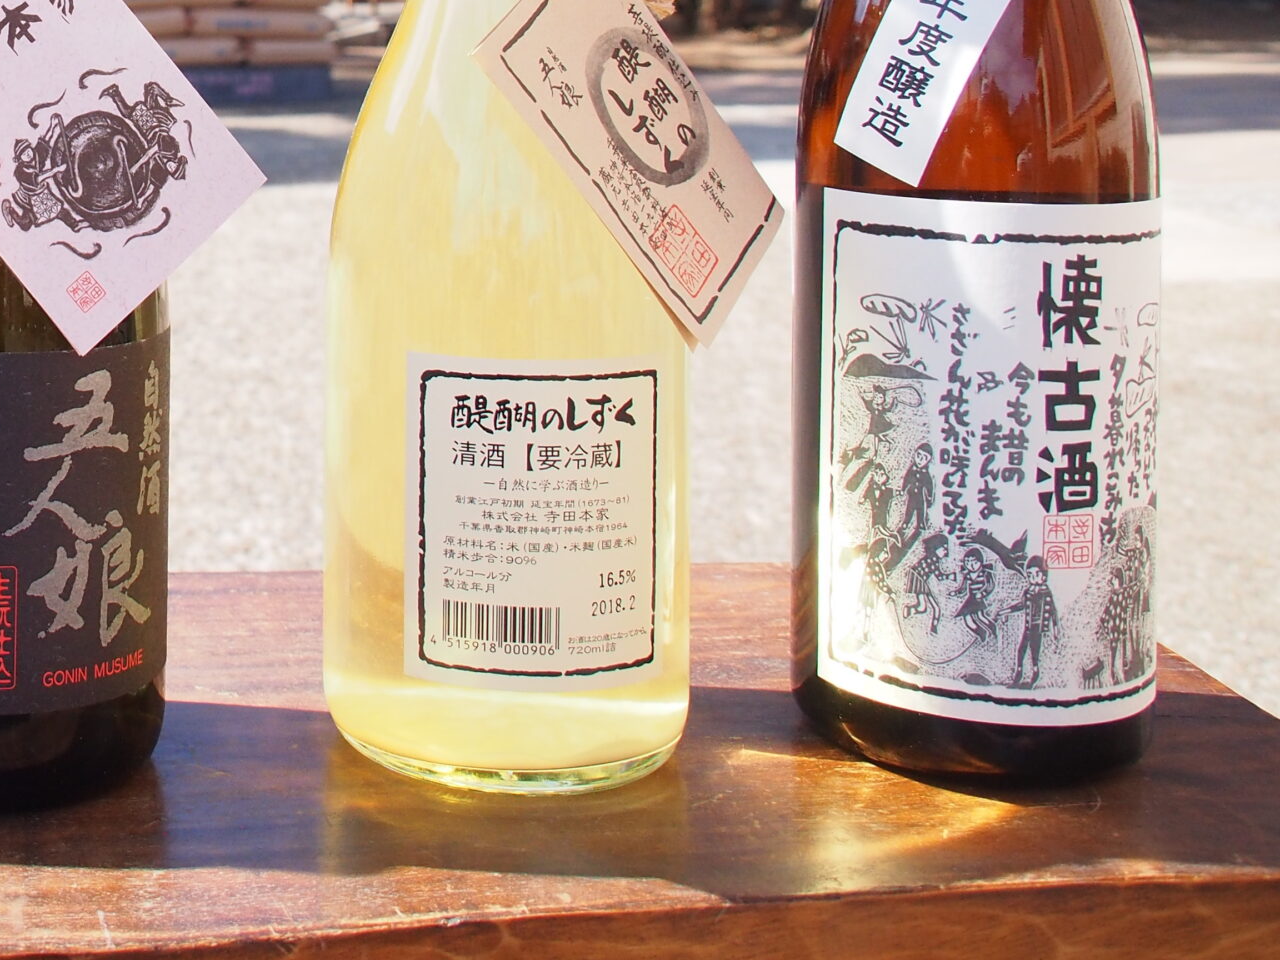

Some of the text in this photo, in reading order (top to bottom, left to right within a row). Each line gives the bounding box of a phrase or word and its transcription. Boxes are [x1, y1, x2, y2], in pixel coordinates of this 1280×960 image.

[1036, 254, 1104, 514] 懐古酒
[450, 394, 637, 435] 醍醐のしずく
[2, 369, 152, 647] 五人娘
[442, 566, 636, 588] アルコール分 16.5%
[442, 578, 637, 617] 製造年月 2018.2
[447, 637, 497, 654] 515918
[504, 643, 556, 657] 000906
[42, 648, 144, 689] GONIN MUSUME
